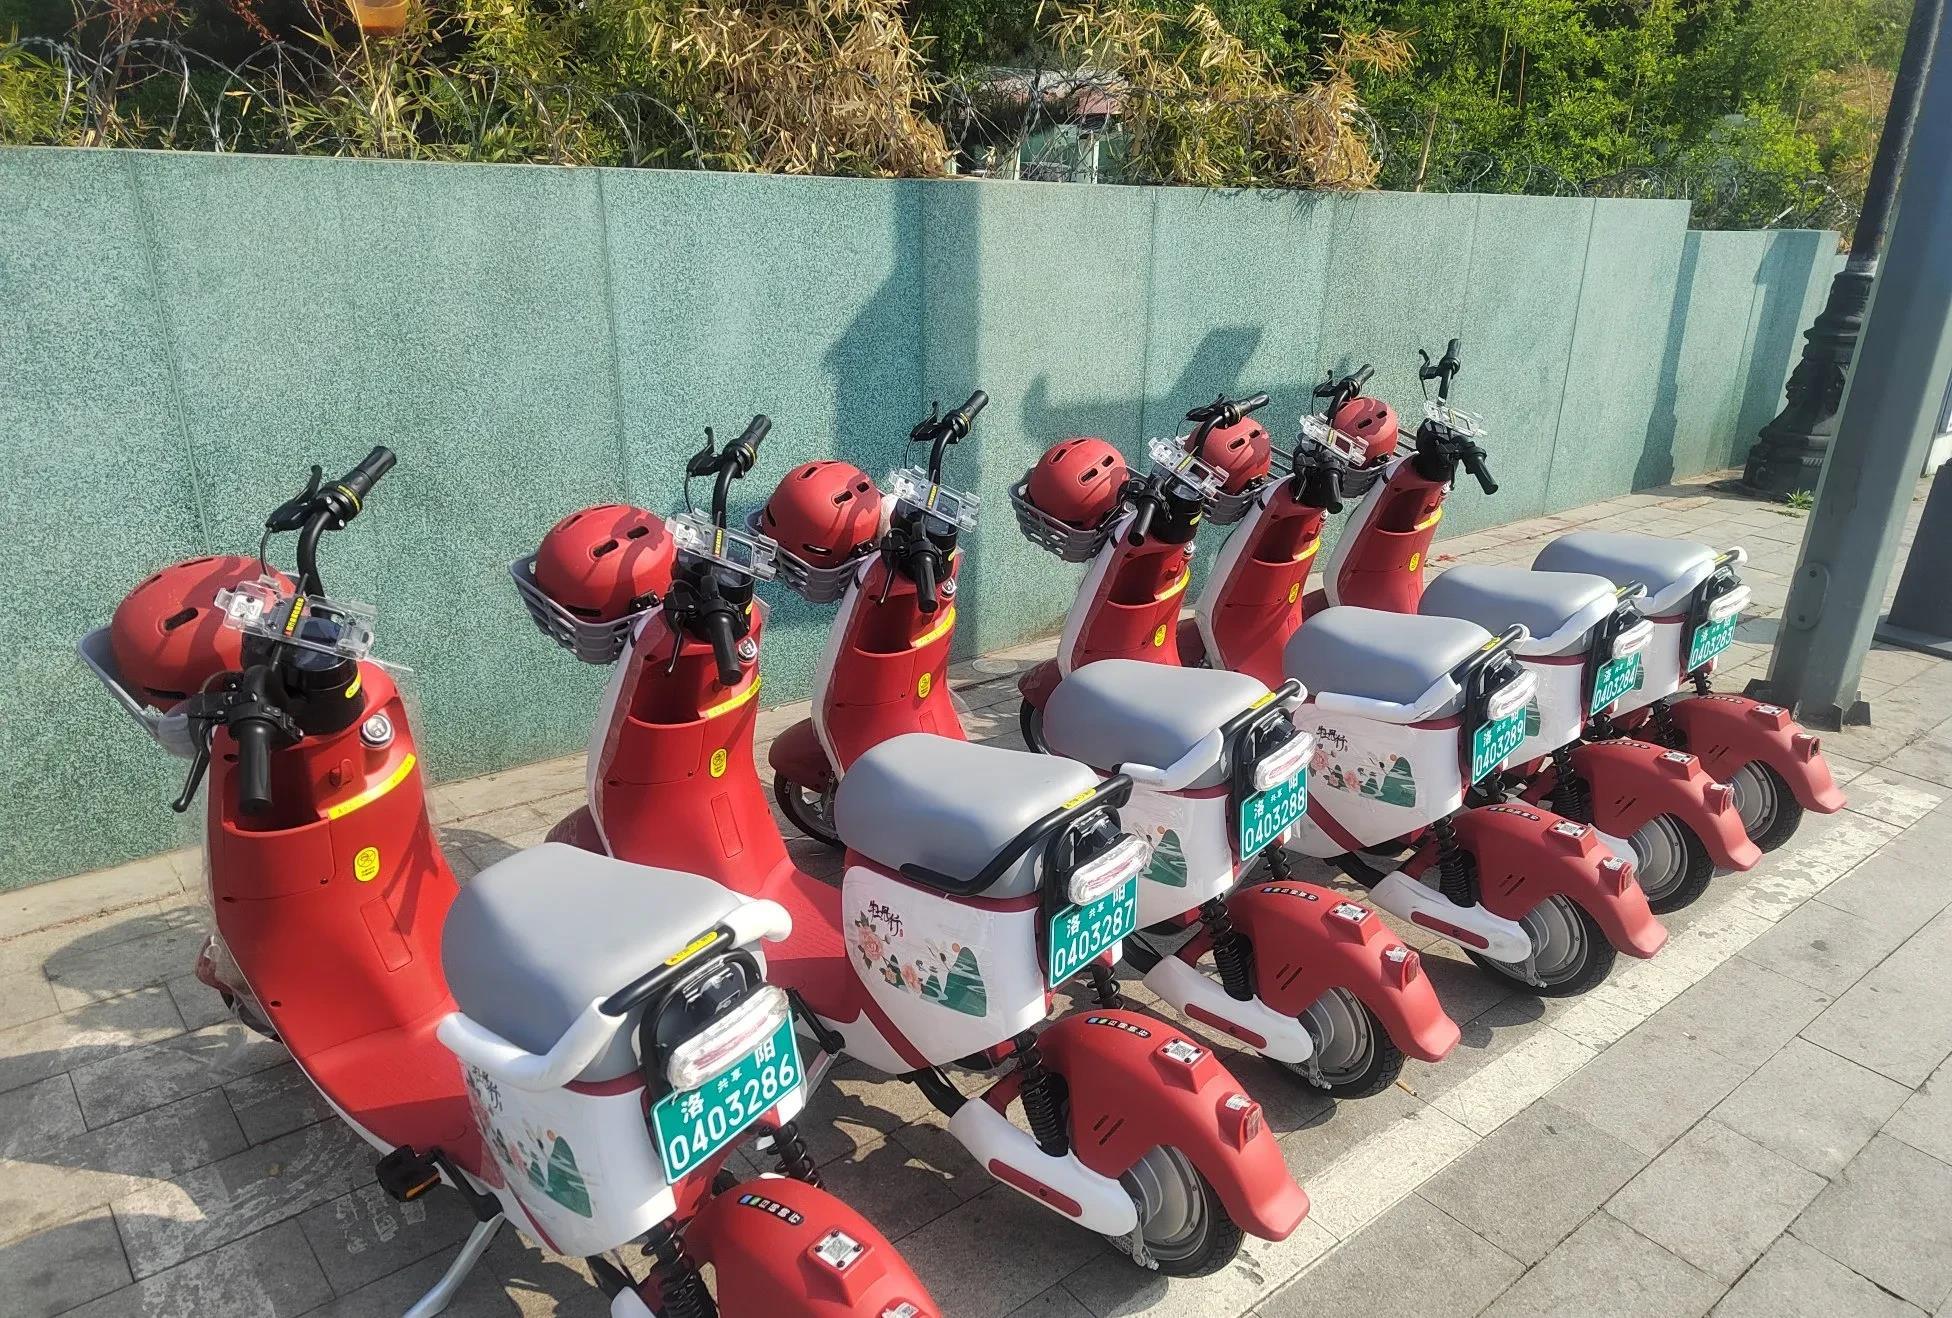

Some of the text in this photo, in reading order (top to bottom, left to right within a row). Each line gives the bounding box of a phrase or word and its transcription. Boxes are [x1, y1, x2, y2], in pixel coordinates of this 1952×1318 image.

[1595, 665, 1636, 709] 0403284
[1476, 719, 1523, 777] 0403289
[1245, 786, 1305, 852] 0403288
[1254, 799, 1264, 819] 洛
[1055, 897, 1133, 977] 0403287
[1067, 914, 1080, 938] 洛
[669, 1054, 794, 1170] 0403286
[681, 1092, 704, 1123] 洛
